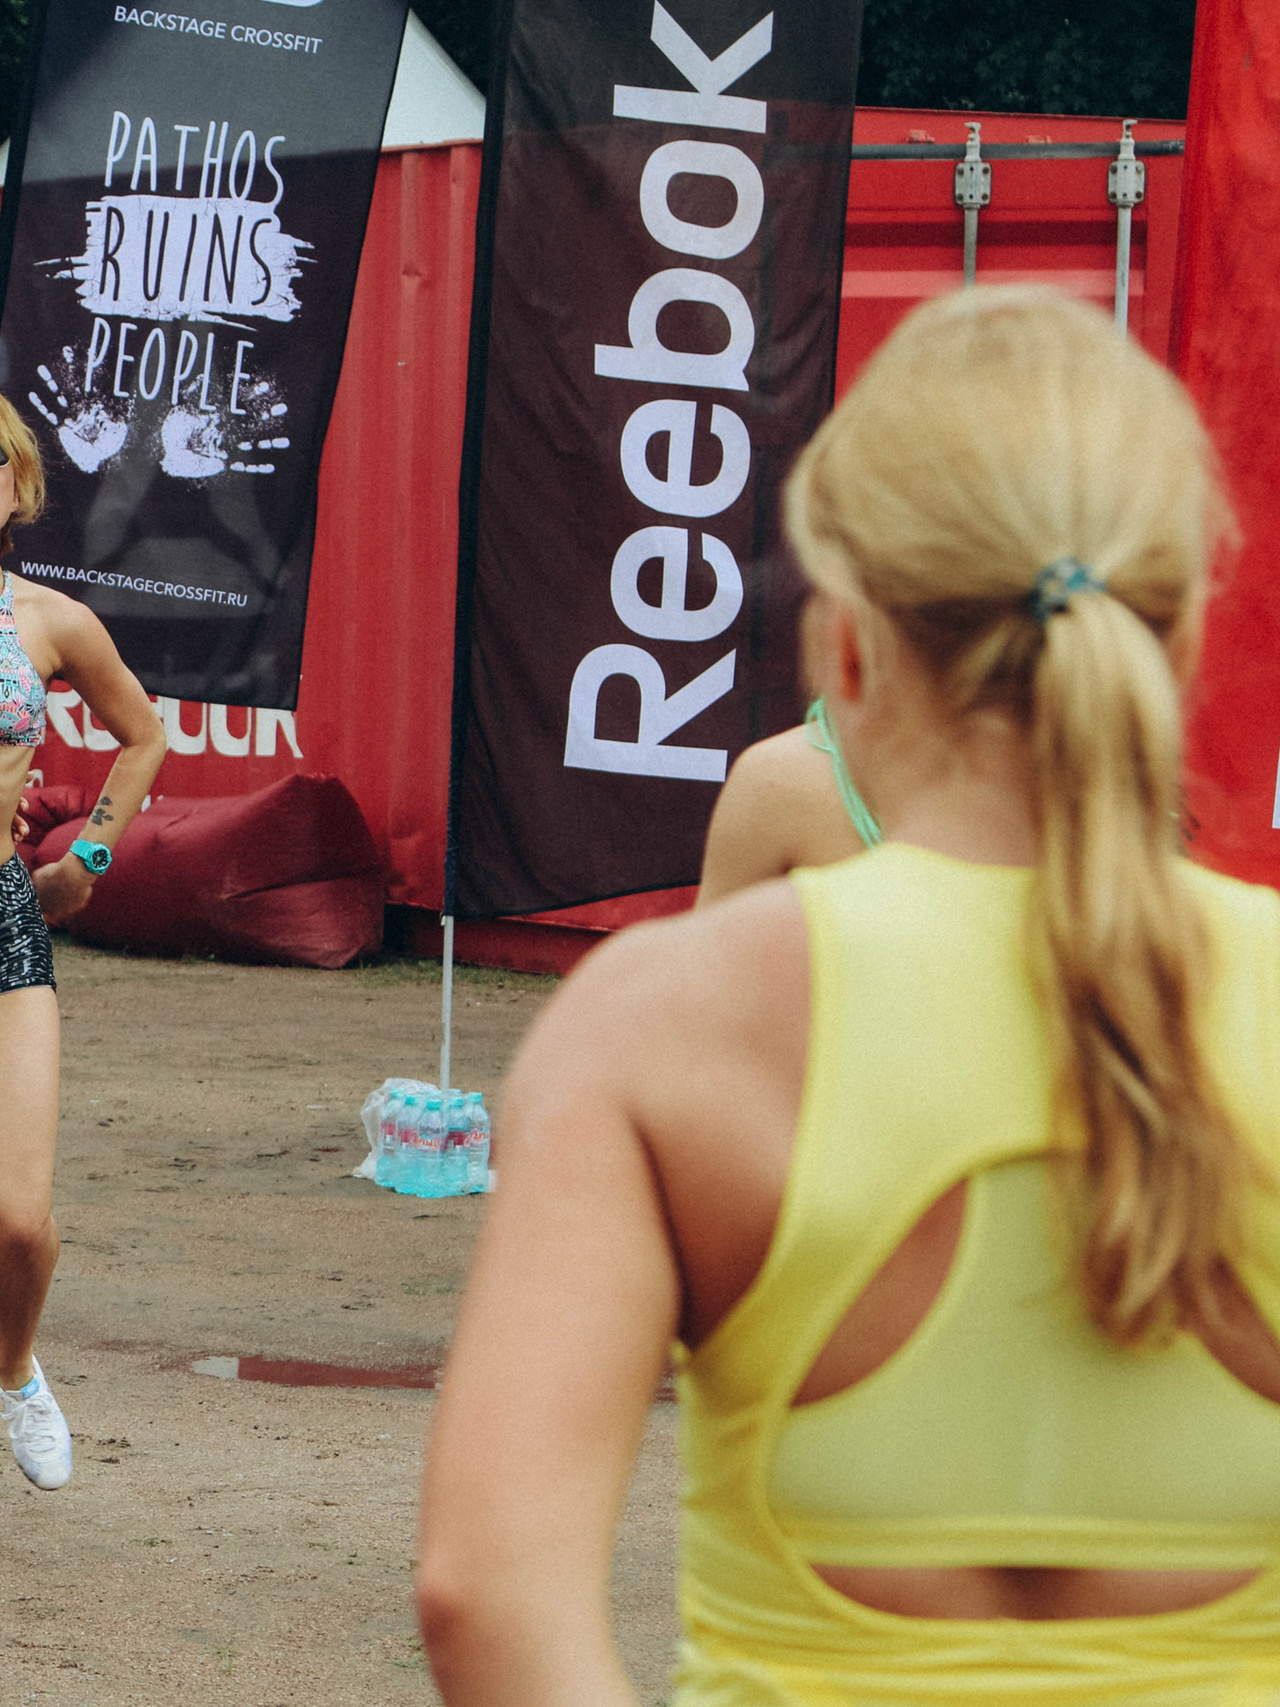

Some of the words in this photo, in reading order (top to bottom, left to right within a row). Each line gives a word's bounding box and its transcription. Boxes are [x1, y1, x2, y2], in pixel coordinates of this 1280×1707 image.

[113, 5, 227, 39] BACKSTAGE
[230, 25, 323, 54] CROSSFIT
[104, 111, 286, 203] PATHOS
[98, 205, 273, 306] RUINS
[84, 316, 255, 416] PEOPLE
[564, 0, 773, 782] Reebok
[20, 560, 248, 607] WWW.BACKSTAGECROSSFIT.RU
